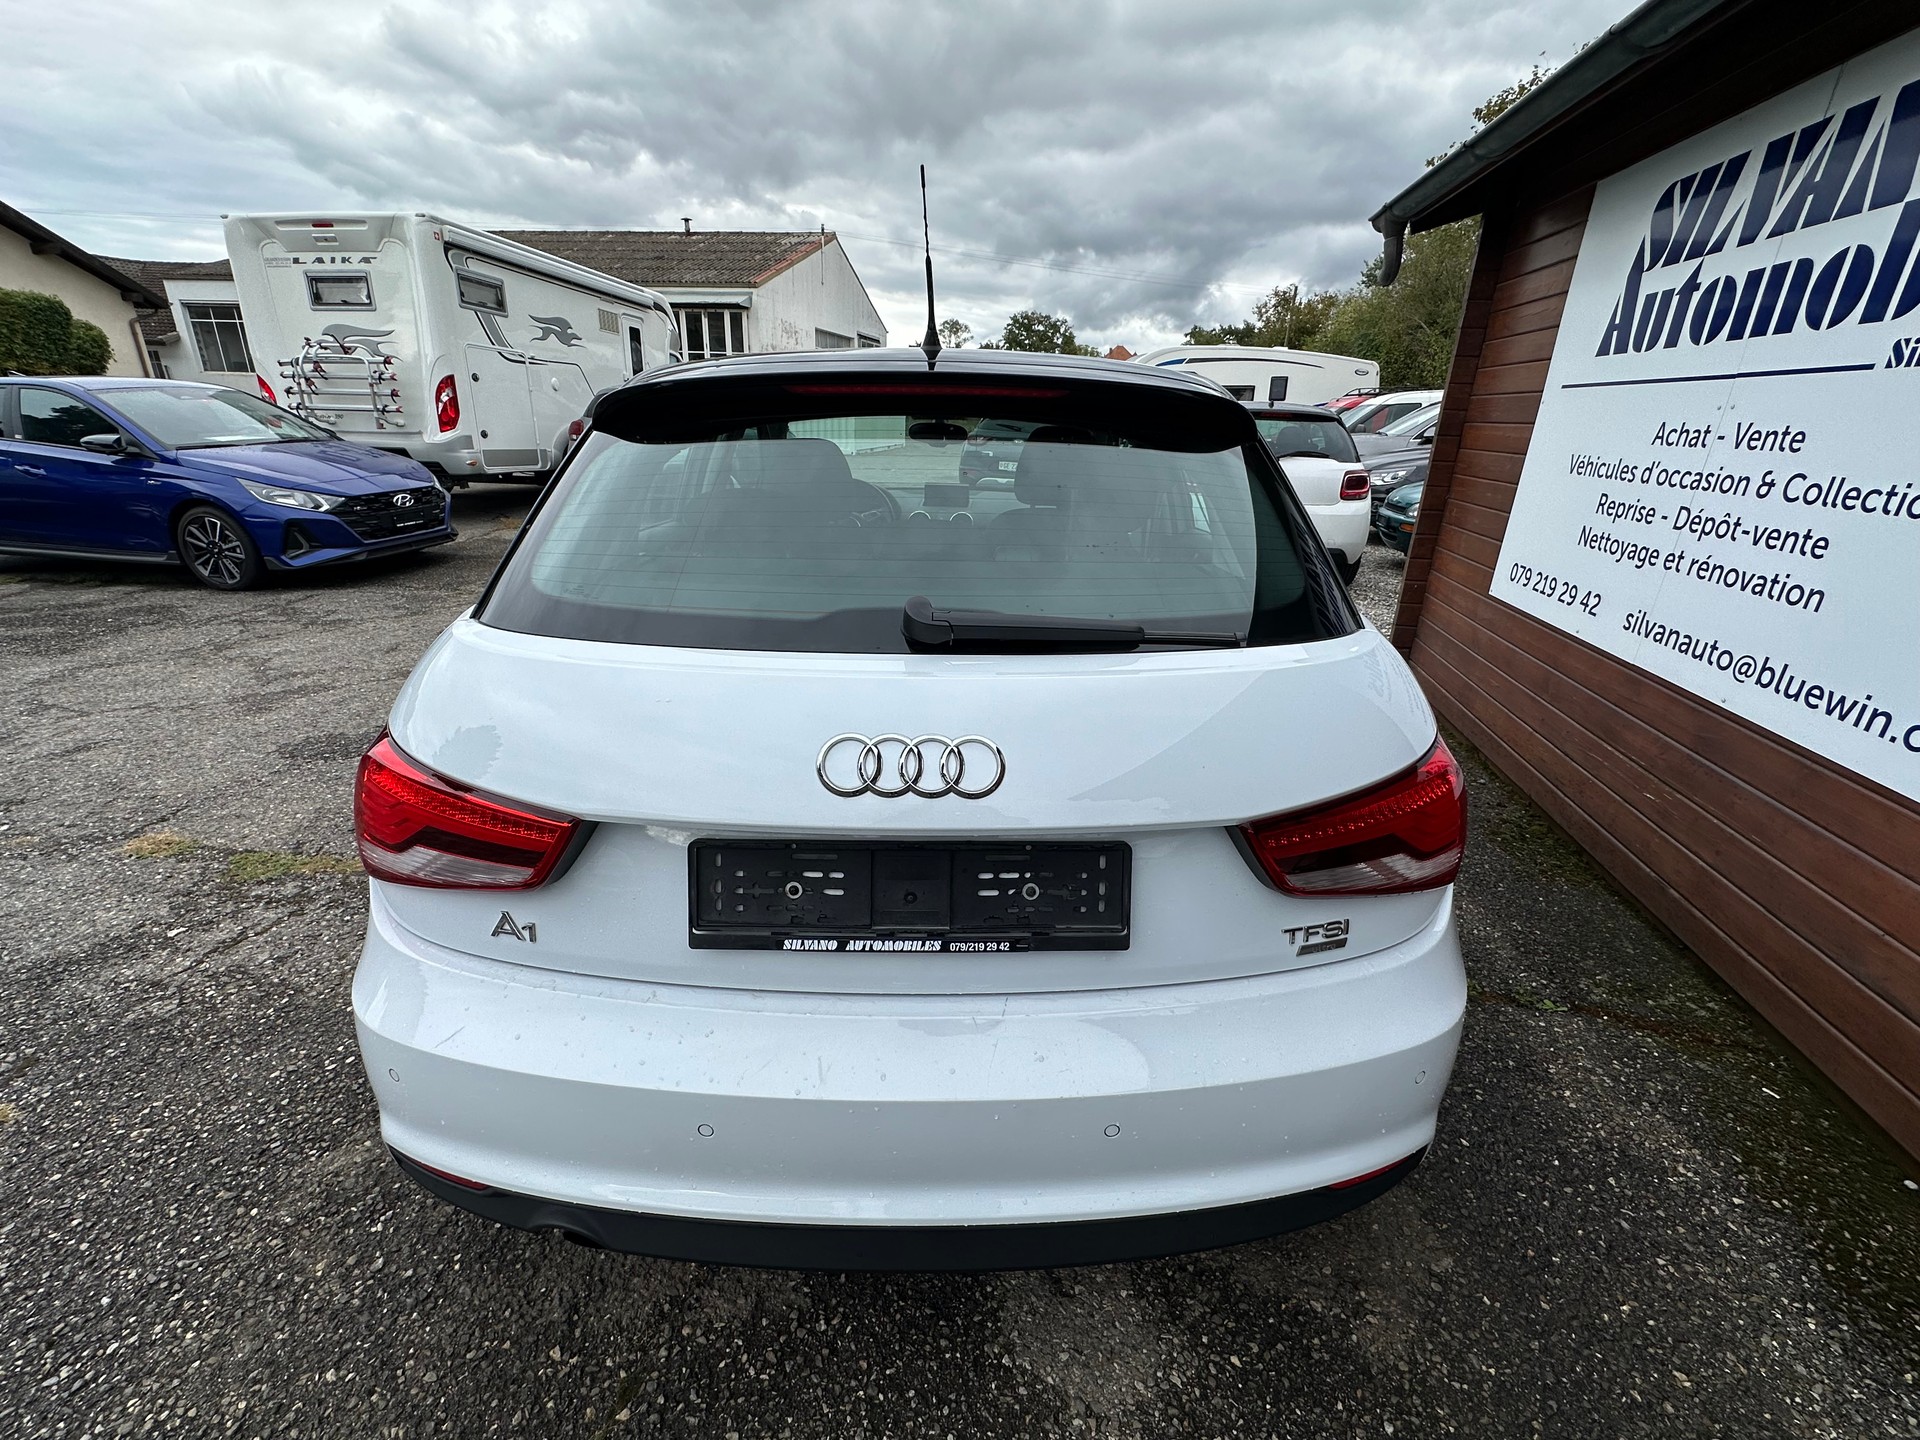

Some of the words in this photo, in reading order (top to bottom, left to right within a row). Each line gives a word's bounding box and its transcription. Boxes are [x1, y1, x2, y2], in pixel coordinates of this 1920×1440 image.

[292, 256, 377, 264] LAIKA
[1651, 421, 1711, 448] Achat
[1734, 422, 1807, 454] Vente
[1569, 454, 1638, 483] Véhicules
[1640, 460, 1751, 497] d'occasion
[1755, 470, 1776, 499] &
[1595, 492, 1656, 525] Reprise
[1672, 505, 1830, 560] Dépôt-vente
[1577, 525, 1660, 569] Nettoyage
[1663, 551, 1685, 574] et
[1686, 554, 1825, 613] rénovation
[1509, 562, 1533, 588] 079
[1531, 571, 1558, 598] 219
[1557, 581, 1578, 606] 29
[1579, 590, 1602, 617] 42
[491, 910, 537, 943] A1
[1281, 918, 1350, 945] TFSI
[783, 939, 838, 951] SILVANO
[845, 940, 942, 951] AUTOMOBILES
[950, 942, 985, 952] 079/219
[986, 942, 998, 951] 29
[999, 942, 1010, 951] 42
